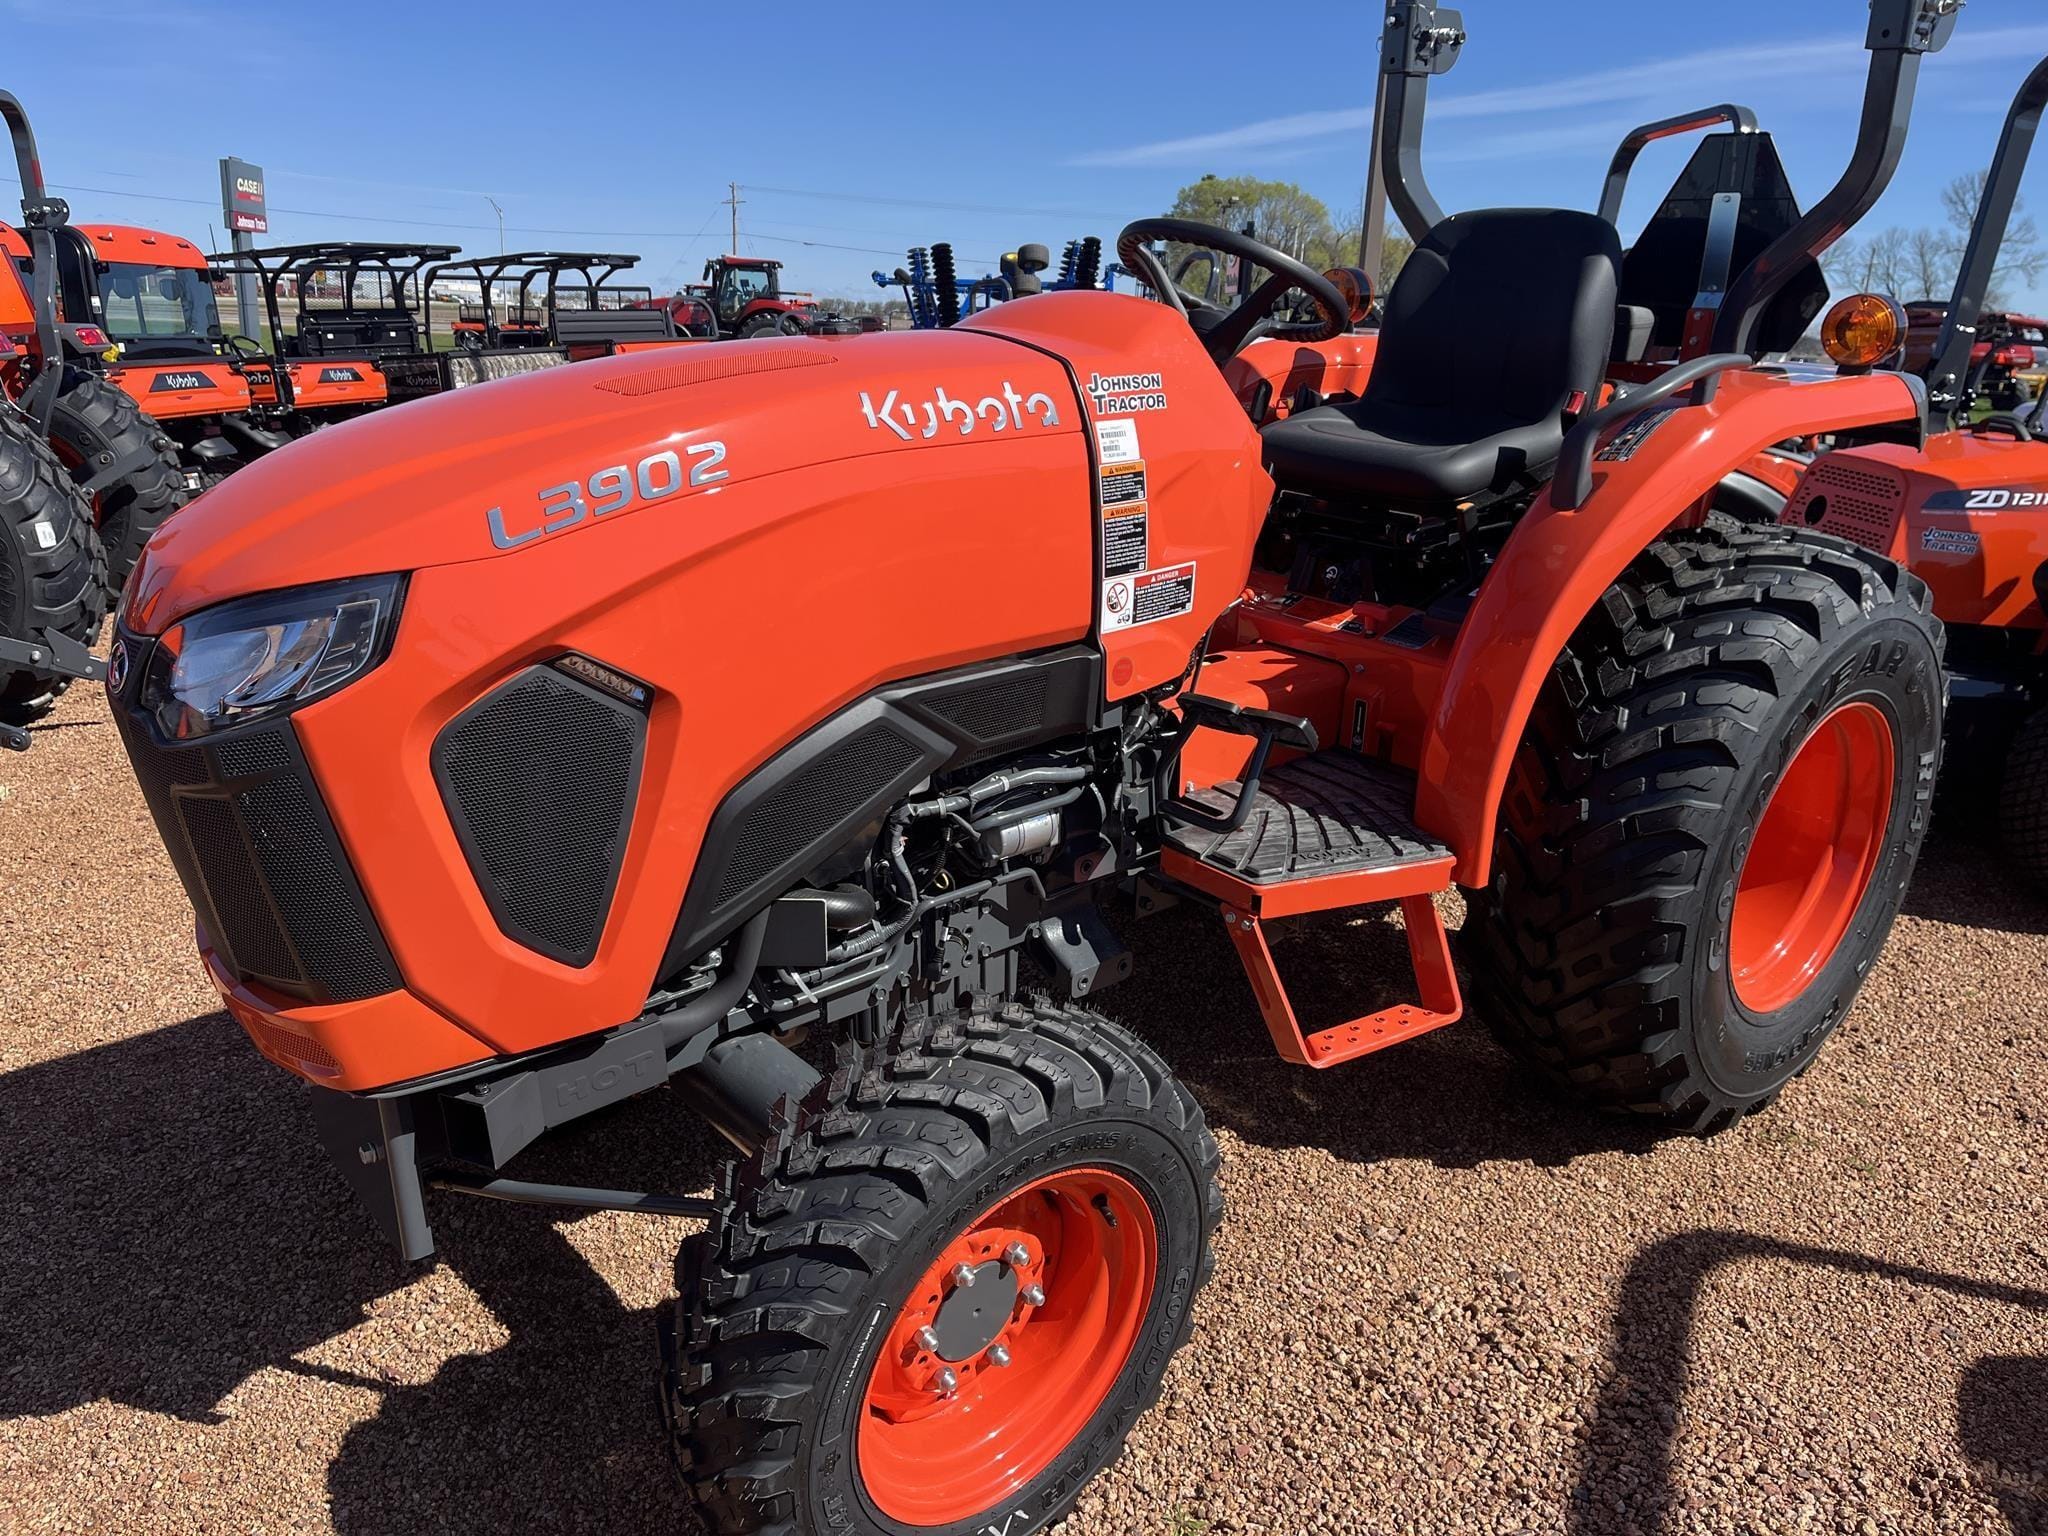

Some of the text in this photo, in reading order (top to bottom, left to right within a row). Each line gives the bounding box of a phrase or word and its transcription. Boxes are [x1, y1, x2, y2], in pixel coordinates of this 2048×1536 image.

[236, 177, 258, 195] CASE
[165, 373, 199, 388] Kubota
[405, 375, 439, 386] Kubota
[859, 381, 1060, 441] Kubota
[1114, 465, 1137, 474] WARNING
[486, 440, 729, 550] L3902
[1964, 489, 2011, 509] ZD
[1115, 506, 1141, 516] WARNING
[1156, 570, 1179, 581] DANGER
[555, 1050, 654, 1109] HOT
